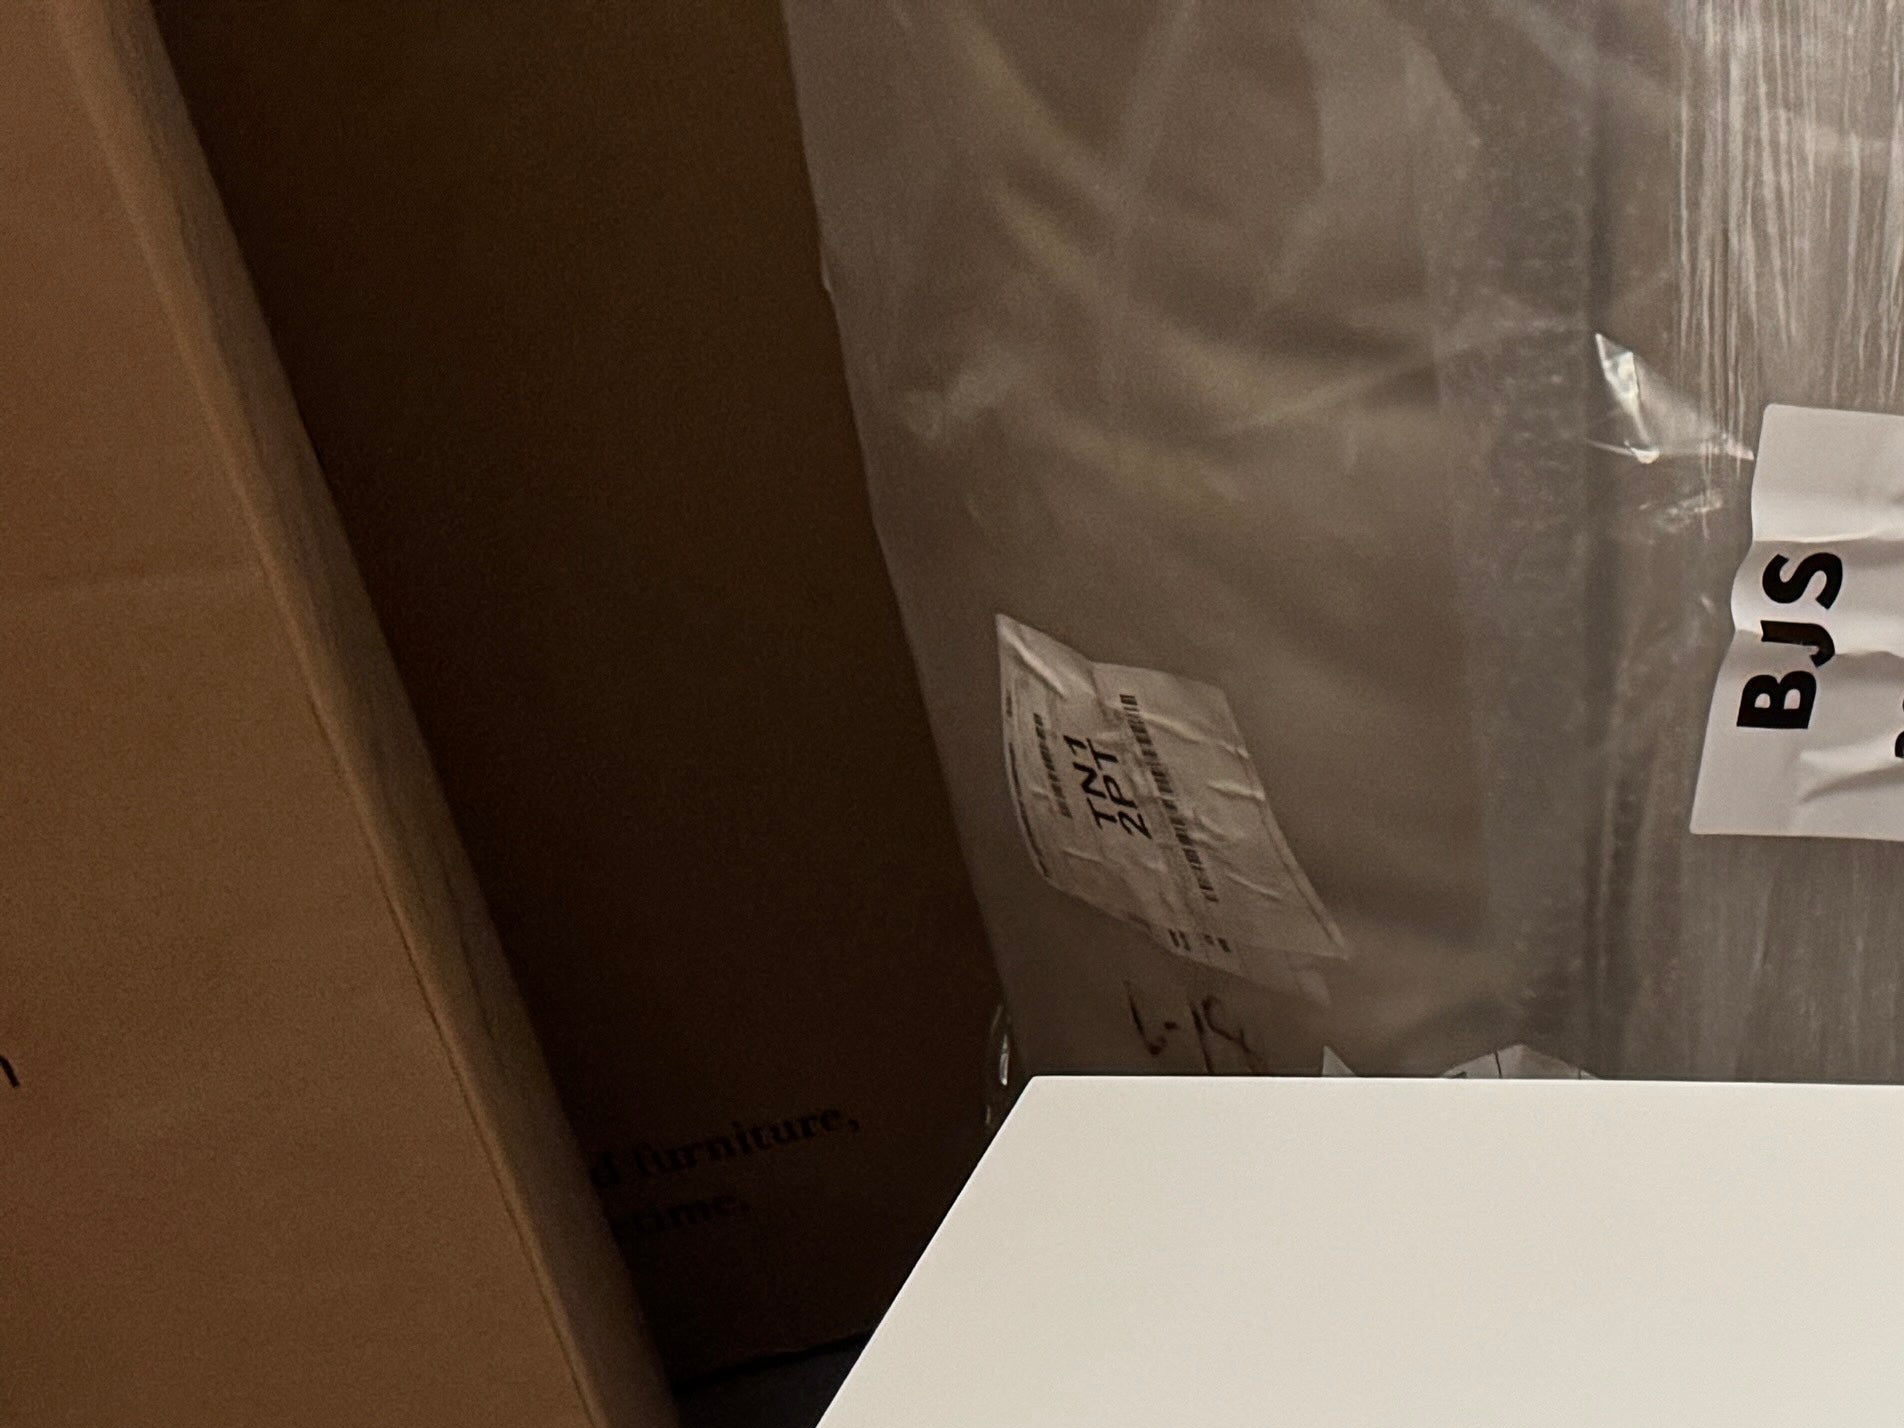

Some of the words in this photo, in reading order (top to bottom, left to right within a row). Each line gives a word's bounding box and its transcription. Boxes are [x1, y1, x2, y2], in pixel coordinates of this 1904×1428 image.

[1736, 552, 1843, 729] BJS
[1063, 734, 1118, 830] TN1
[1086, 737, 1152, 840] 2PT
[629, 1108, 860, 1179] furniture,
